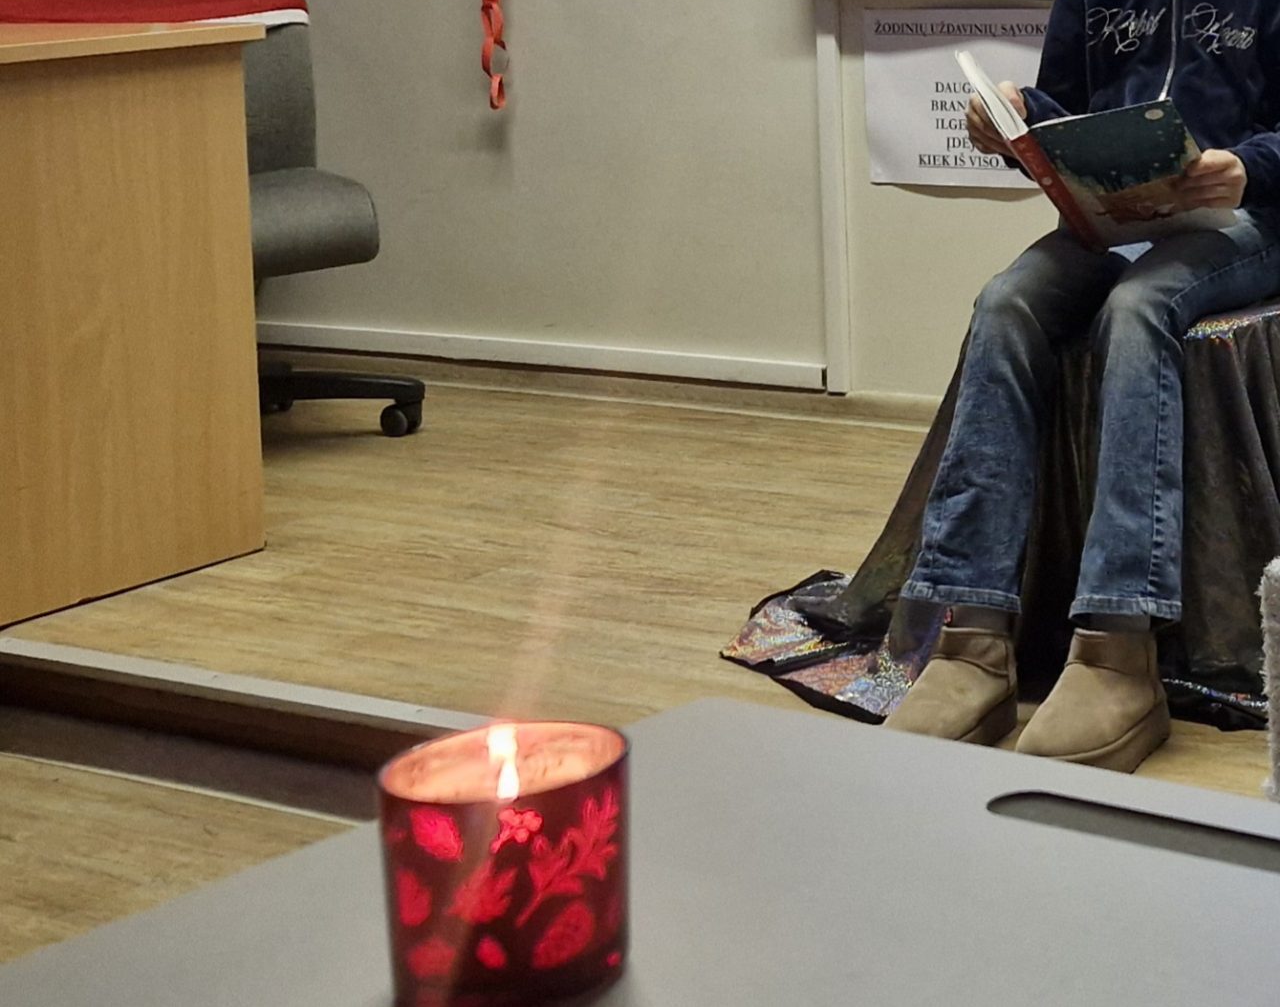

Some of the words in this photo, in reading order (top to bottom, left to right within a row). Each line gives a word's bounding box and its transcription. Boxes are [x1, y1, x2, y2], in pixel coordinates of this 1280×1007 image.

[874, 20, 928, 37] ŽODINIŲ
[931, 20, 998, 37] UŽDAVINIŲ
[1001, 23, 1048, 37] SĄVOK
[935, 82, 975, 94] DAUG
[918, 154, 951, 167] KIEK
[954, 152, 966, 167] IŠ
